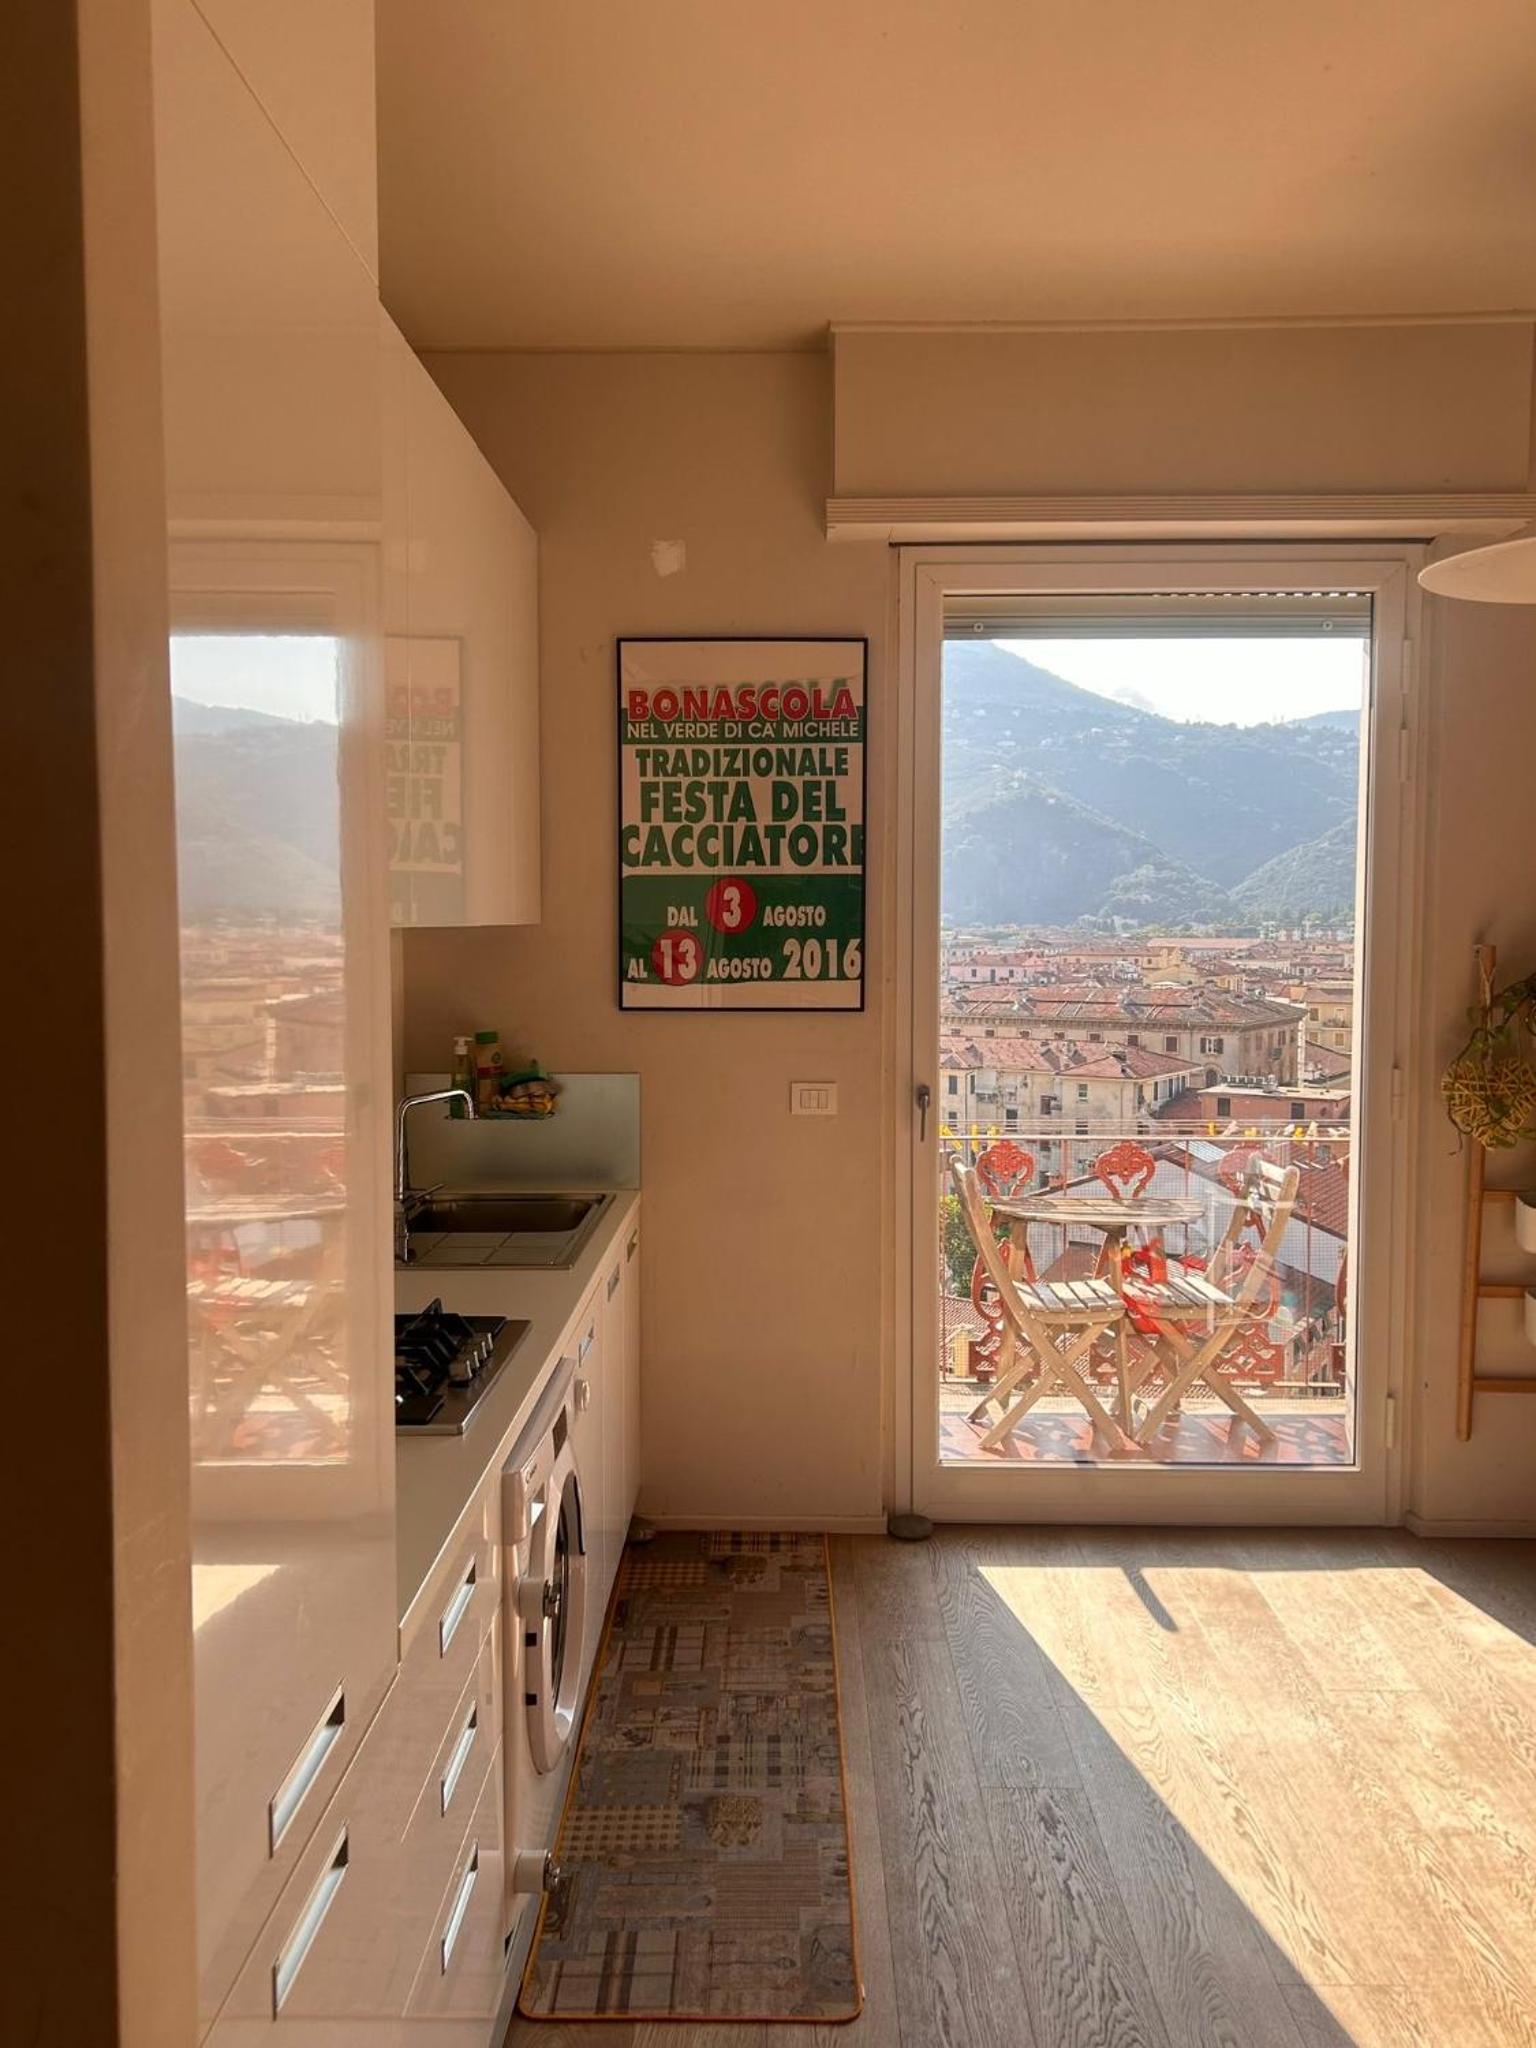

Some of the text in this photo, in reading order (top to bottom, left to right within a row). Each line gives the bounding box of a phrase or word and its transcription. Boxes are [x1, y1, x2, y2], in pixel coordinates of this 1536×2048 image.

[628, 688, 859, 721] BONASCOLA
[627, 721, 859, 738] NEL VERDE DI CA' MICHELE
[636, 748, 849, 778] TRADIZIONALE
[640, 781, 846, 824] FESTA DEL
[667, 886, 827, 928] DAL 3 AGOSTO
[627, 938, 862, 980] AL 13 AGOSTO 2016
